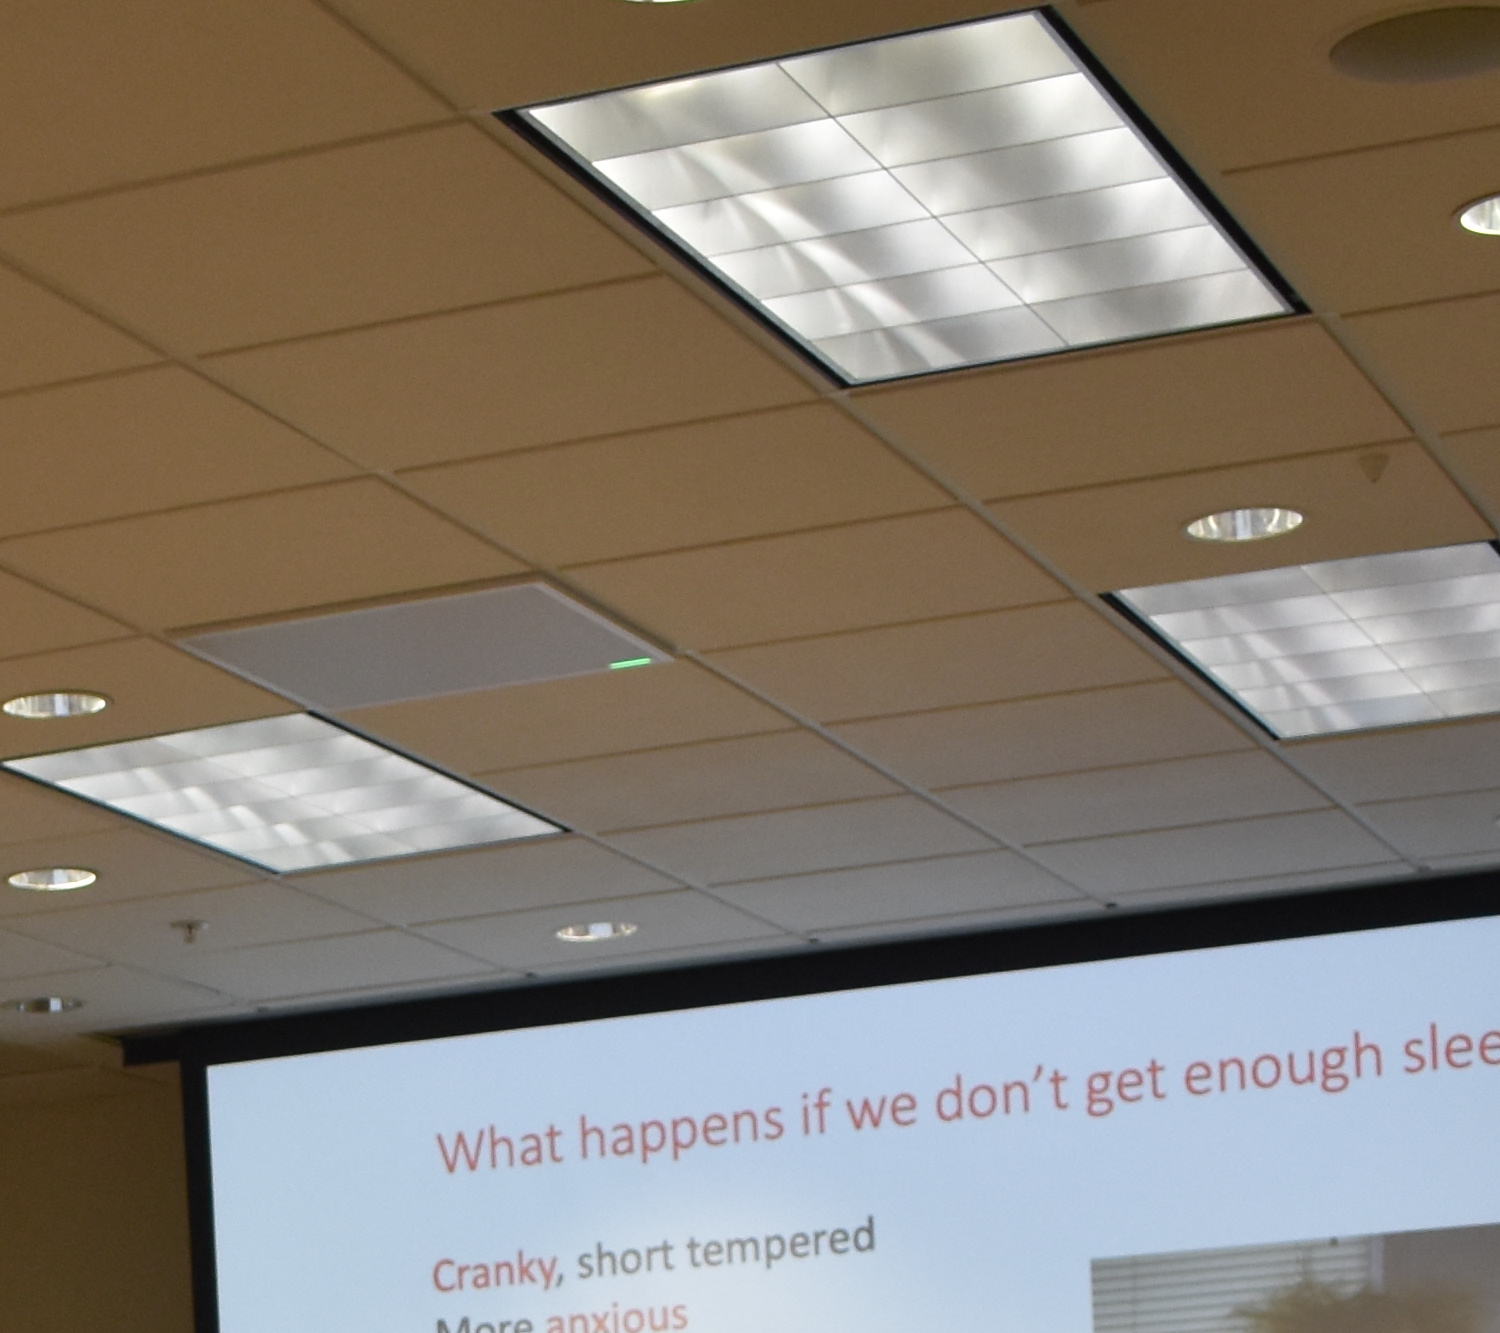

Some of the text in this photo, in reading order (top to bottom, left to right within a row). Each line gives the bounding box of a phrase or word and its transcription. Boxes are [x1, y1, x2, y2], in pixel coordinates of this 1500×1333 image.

[436, 1124, 564, 1175] What
[579, 1106, 785, 1165] happens
[802, 1087, 832, 1136] if
[845, 1092, 918, 1131] we
[935, 1064, 1069, 1123] don't
[1085, 1058, 1166, 1119] get
[1183, 1030, 1383, 1097] enough
[431, 1213, 877, 1294] Cranky, short tempered
